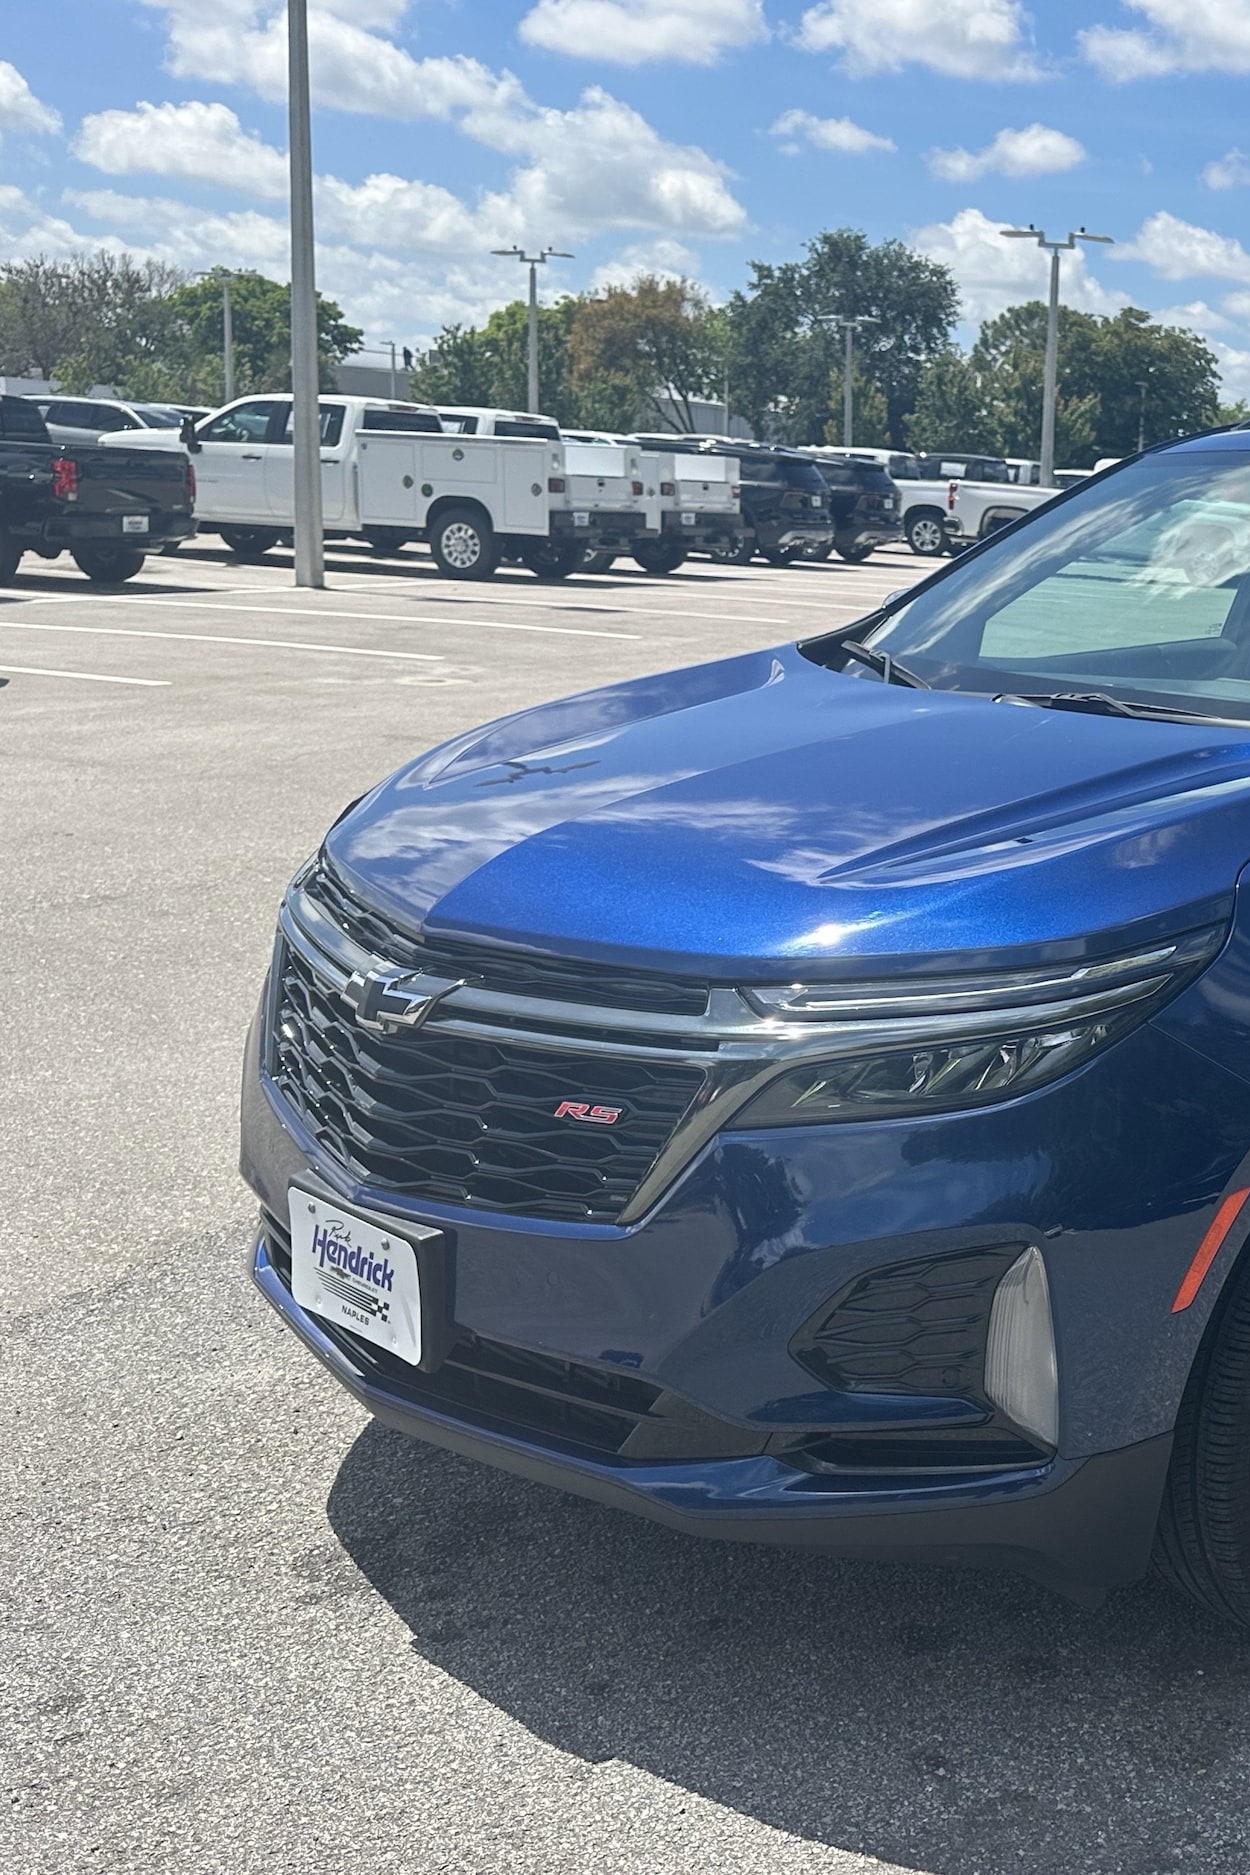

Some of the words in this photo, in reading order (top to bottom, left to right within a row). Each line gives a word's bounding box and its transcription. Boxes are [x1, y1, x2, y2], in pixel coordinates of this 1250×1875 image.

[553, 1101, 623, 1124] RS
[312, 1224, 395, 1292] Hendrick
[341, 1304, 370, 1326] NAPLES
